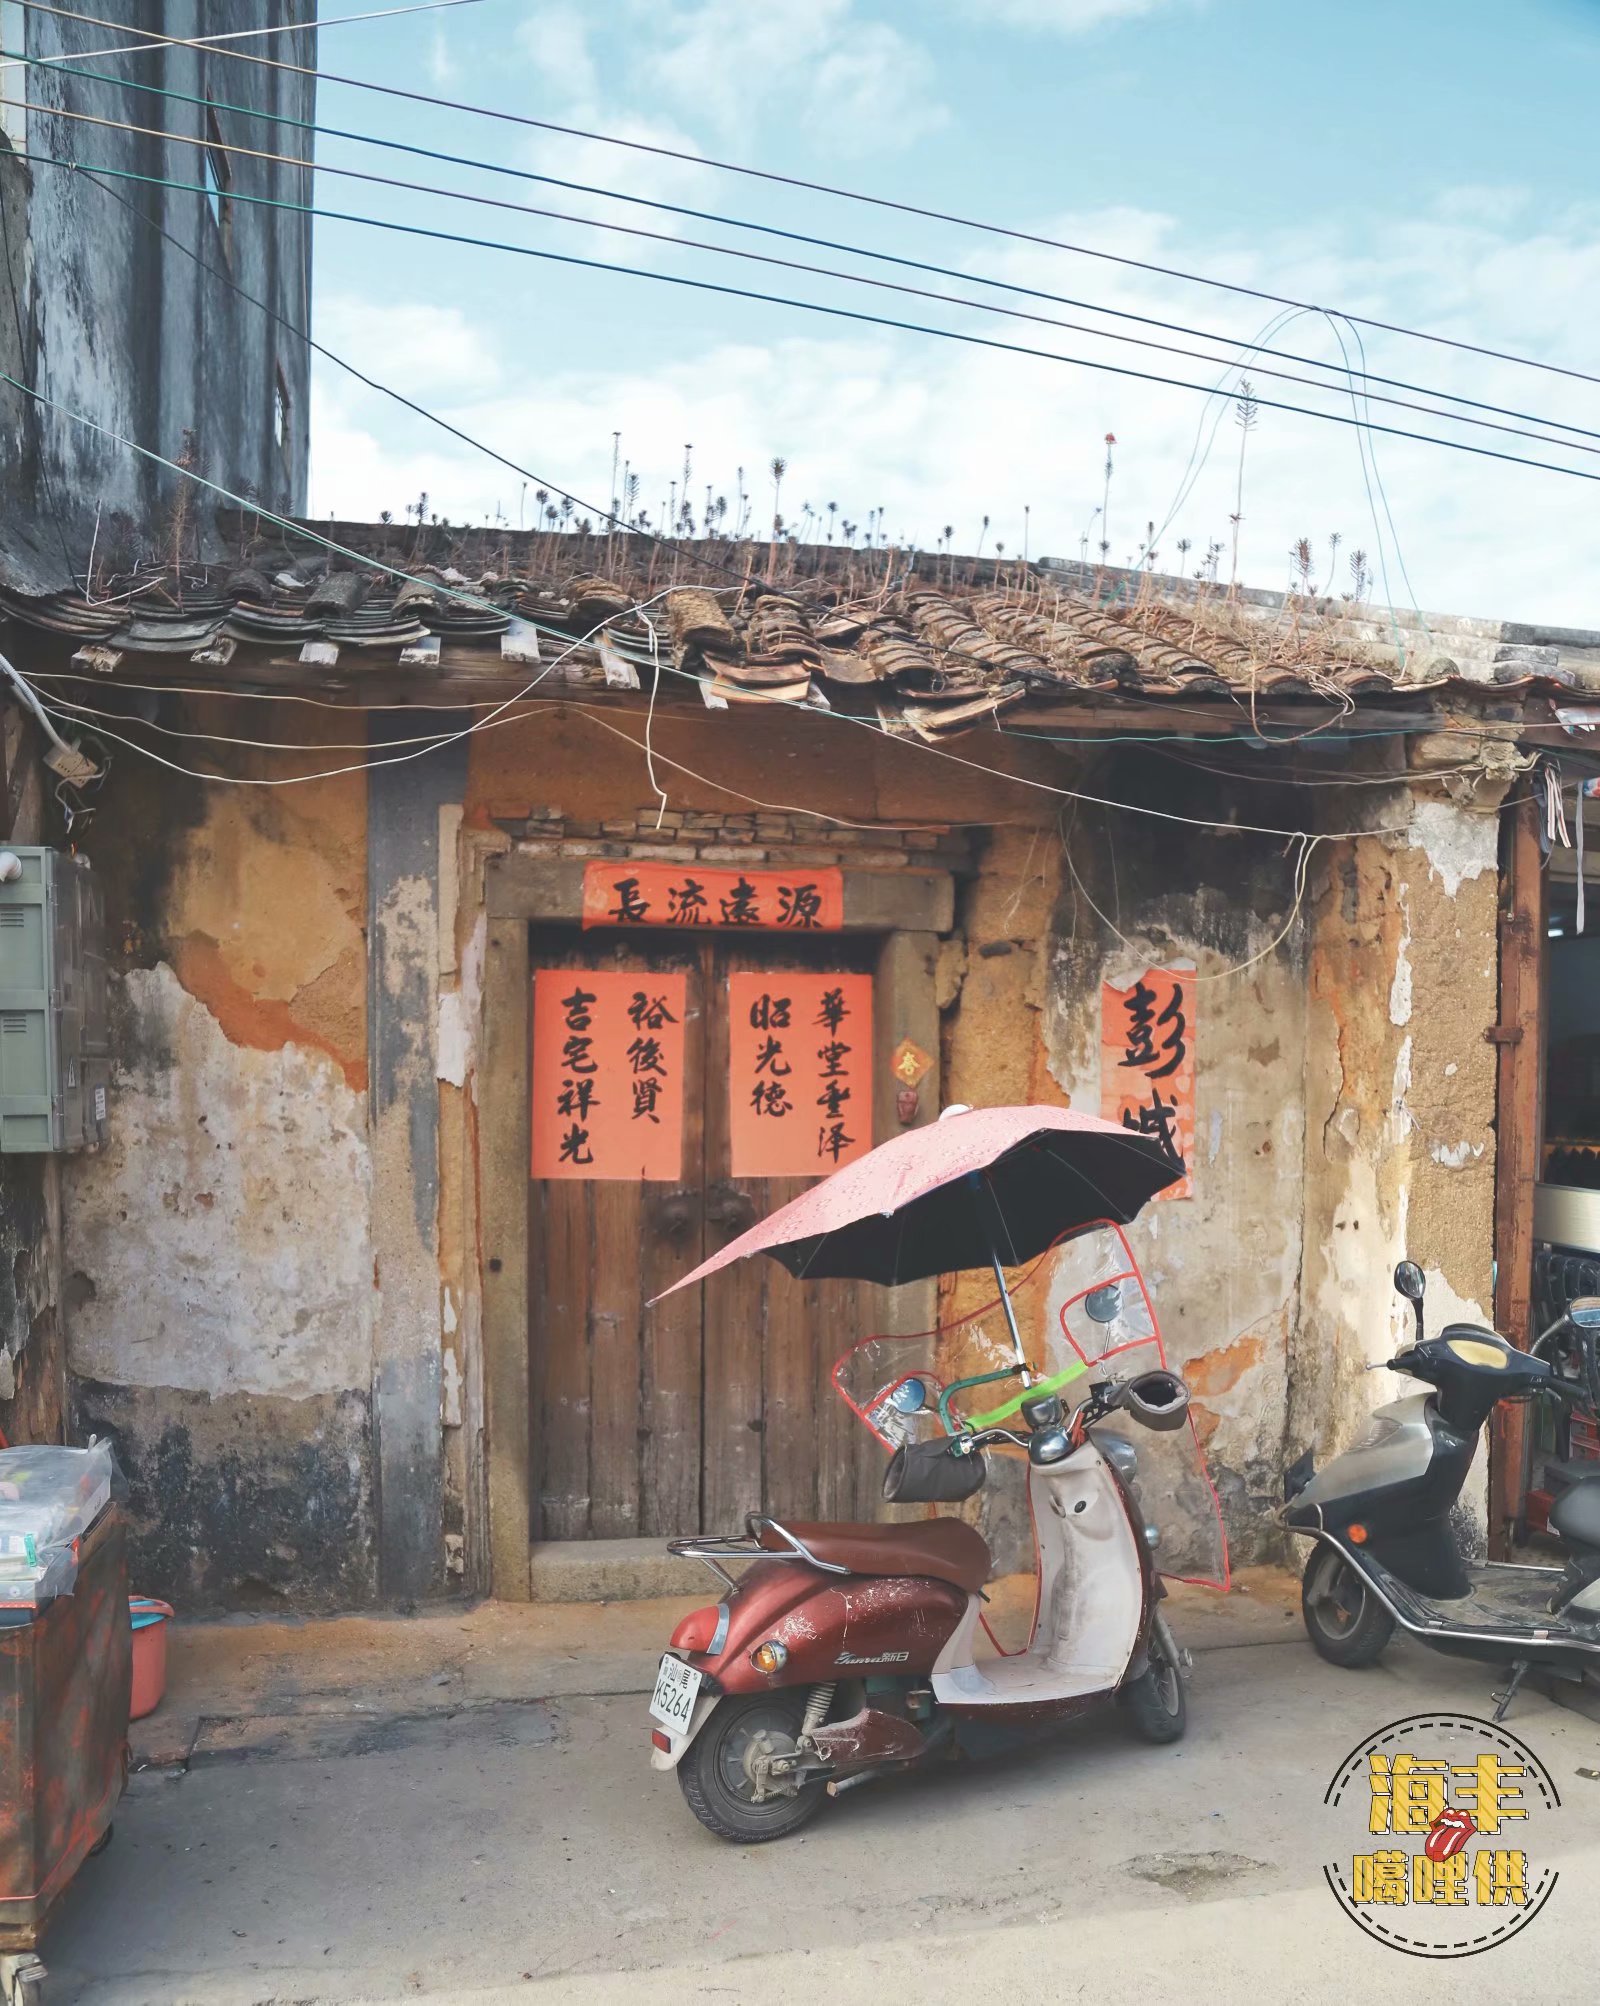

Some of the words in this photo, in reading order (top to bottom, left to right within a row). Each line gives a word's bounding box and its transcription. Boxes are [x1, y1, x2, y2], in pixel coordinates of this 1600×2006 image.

[557, 987, 601, 1164] 吉宅祥光
[654, 1679, 691, 1722] K5264
